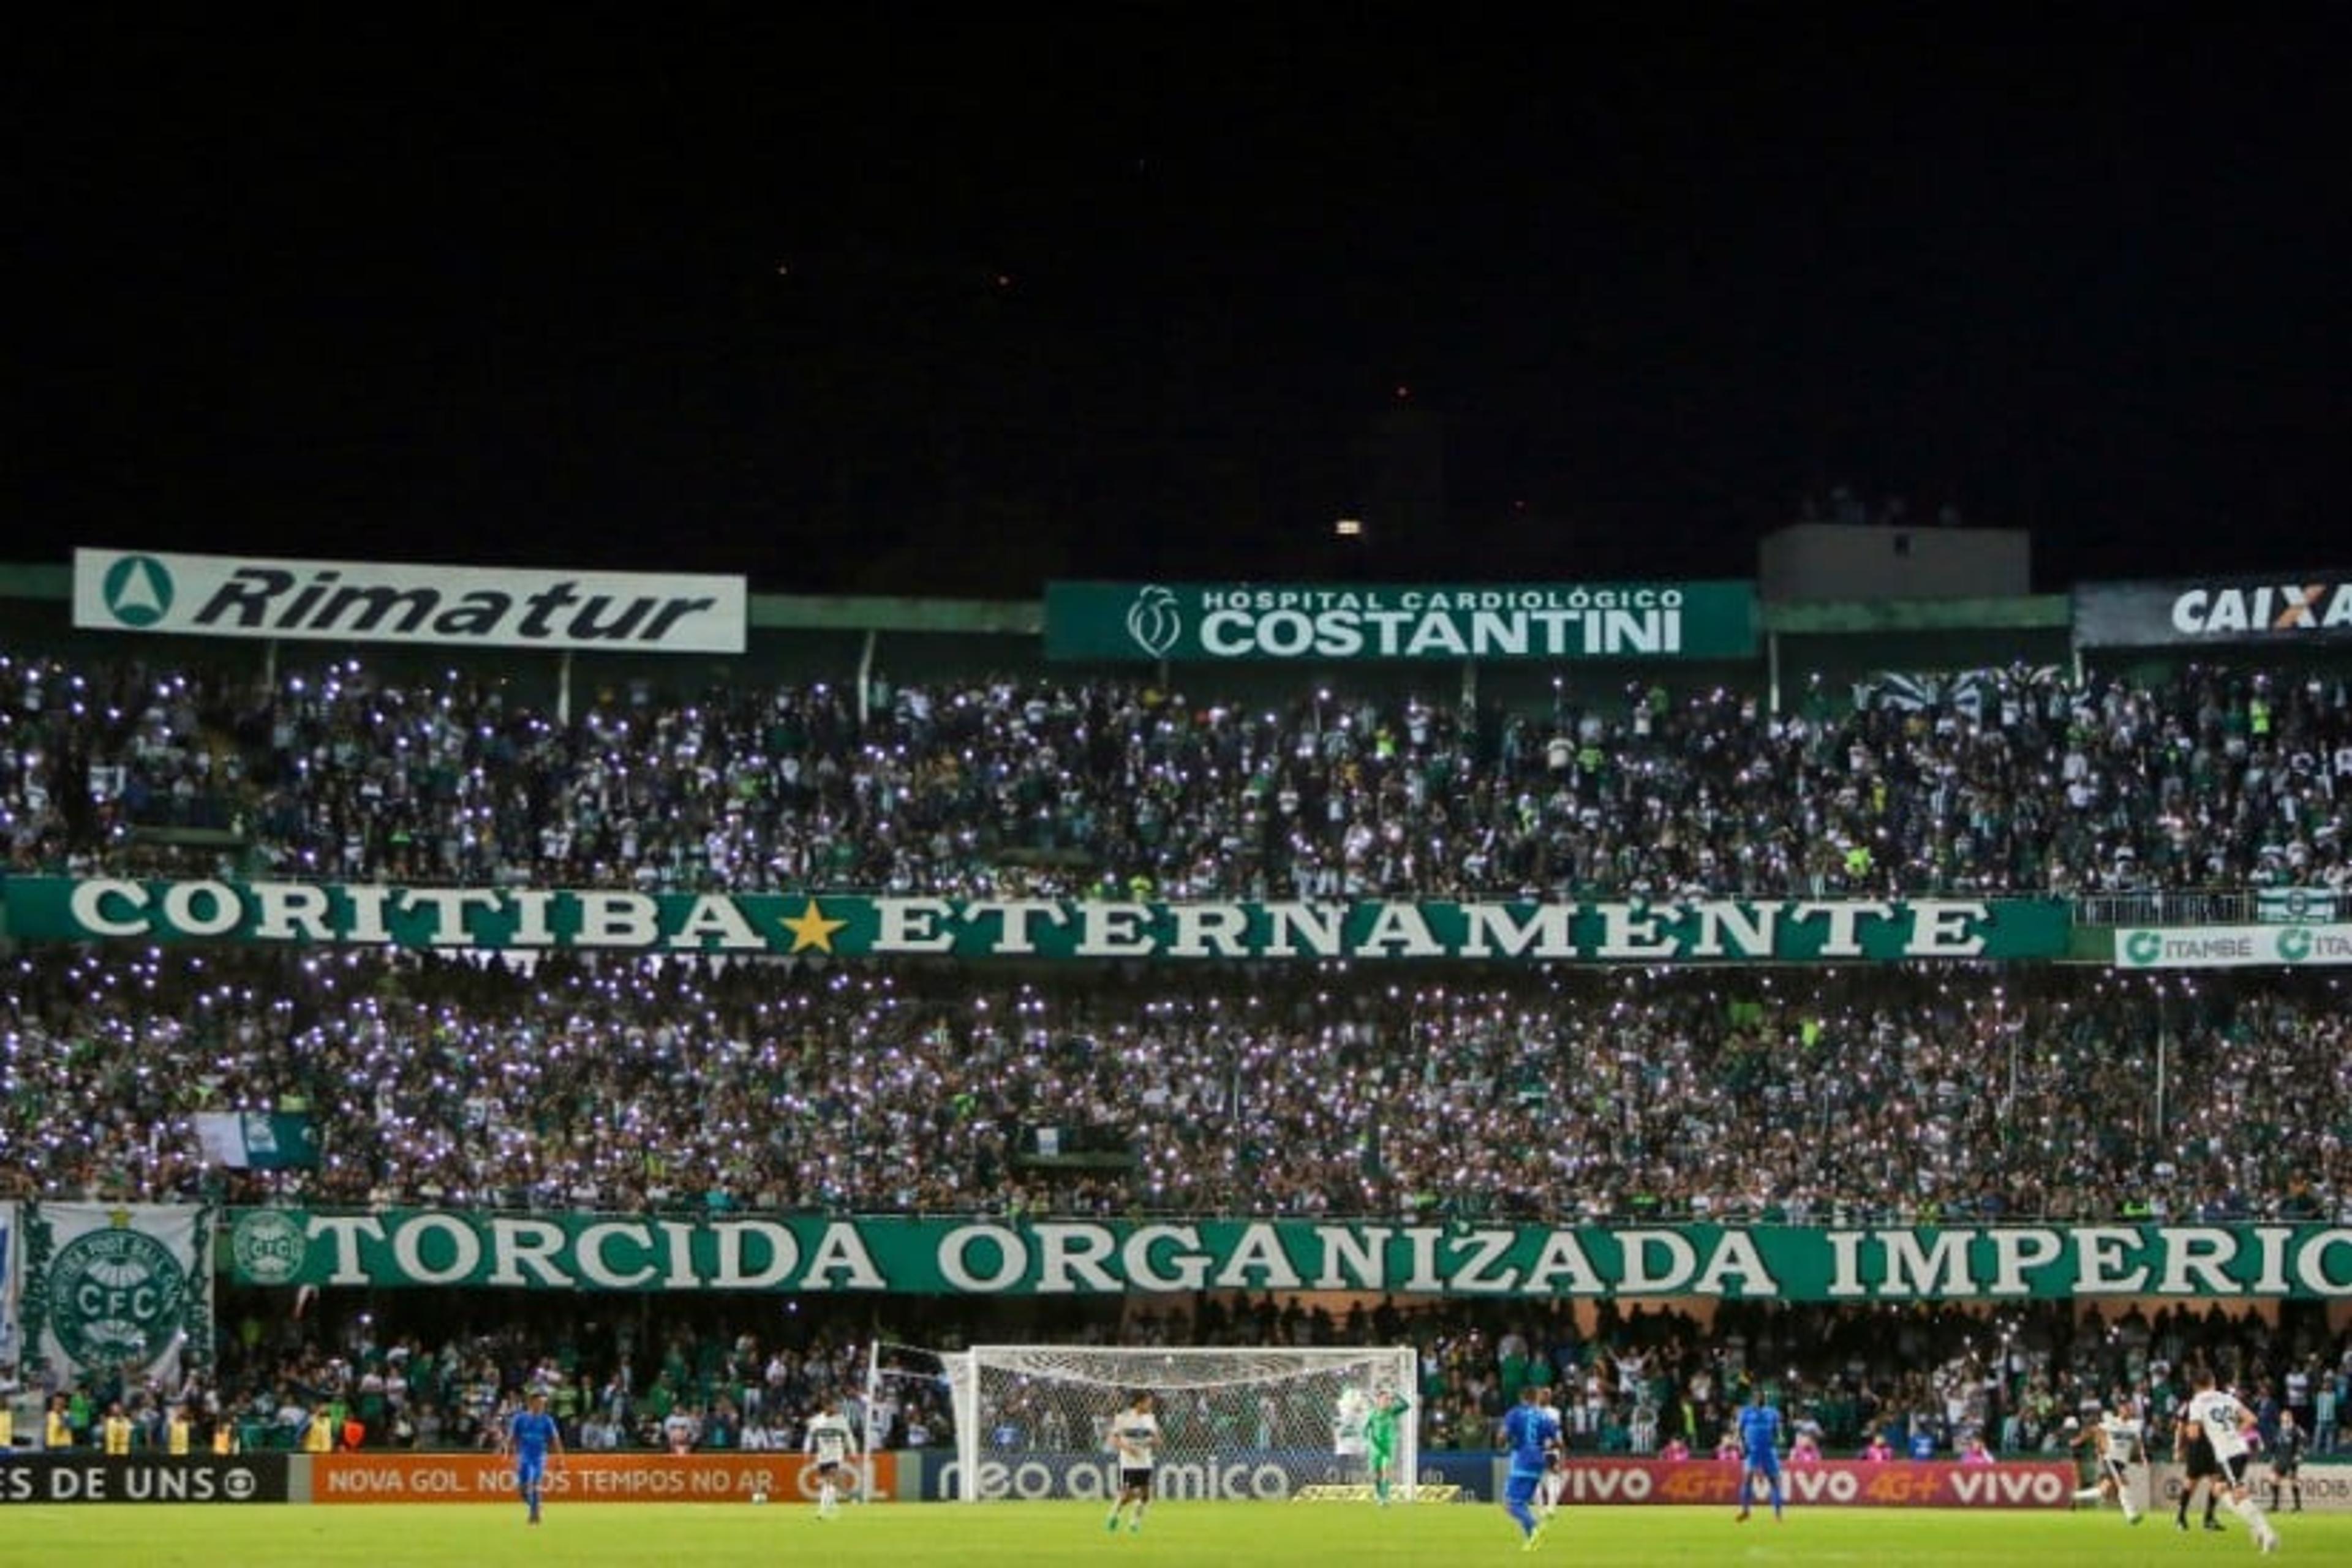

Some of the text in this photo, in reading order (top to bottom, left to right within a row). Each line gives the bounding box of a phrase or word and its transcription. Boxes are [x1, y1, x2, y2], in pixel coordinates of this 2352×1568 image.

[195, 567, 715, 642] Rimatur
[1203, 586, 1683, 609] HOSPITAL CARDIOLÓGICO
[2172, 584, 2352, 633] CAIXA
[1200, 610, 1681, 657] COSTANTINI
[70, 878, 1989, 959] CORITIBA ETERNAMENTE
[307, 1215, 887, 1290] TORCIDA
[937, 1221, 1777, 1295] ORGANIZADA
[78, 1284, 157, 1319] CFC
[51, 1468, 107, 1499] DE
[126, 1468, 214, 1499] UNS
[328, 1469, 403, 1492] NOVA
[478, 1469, 571, 1493] NOOS
[578, 1469, 685, 1493] TEMPOS
[691, 1470, 731, 1493] NO
[1950, 1472, 2063, 1502] VIVO
